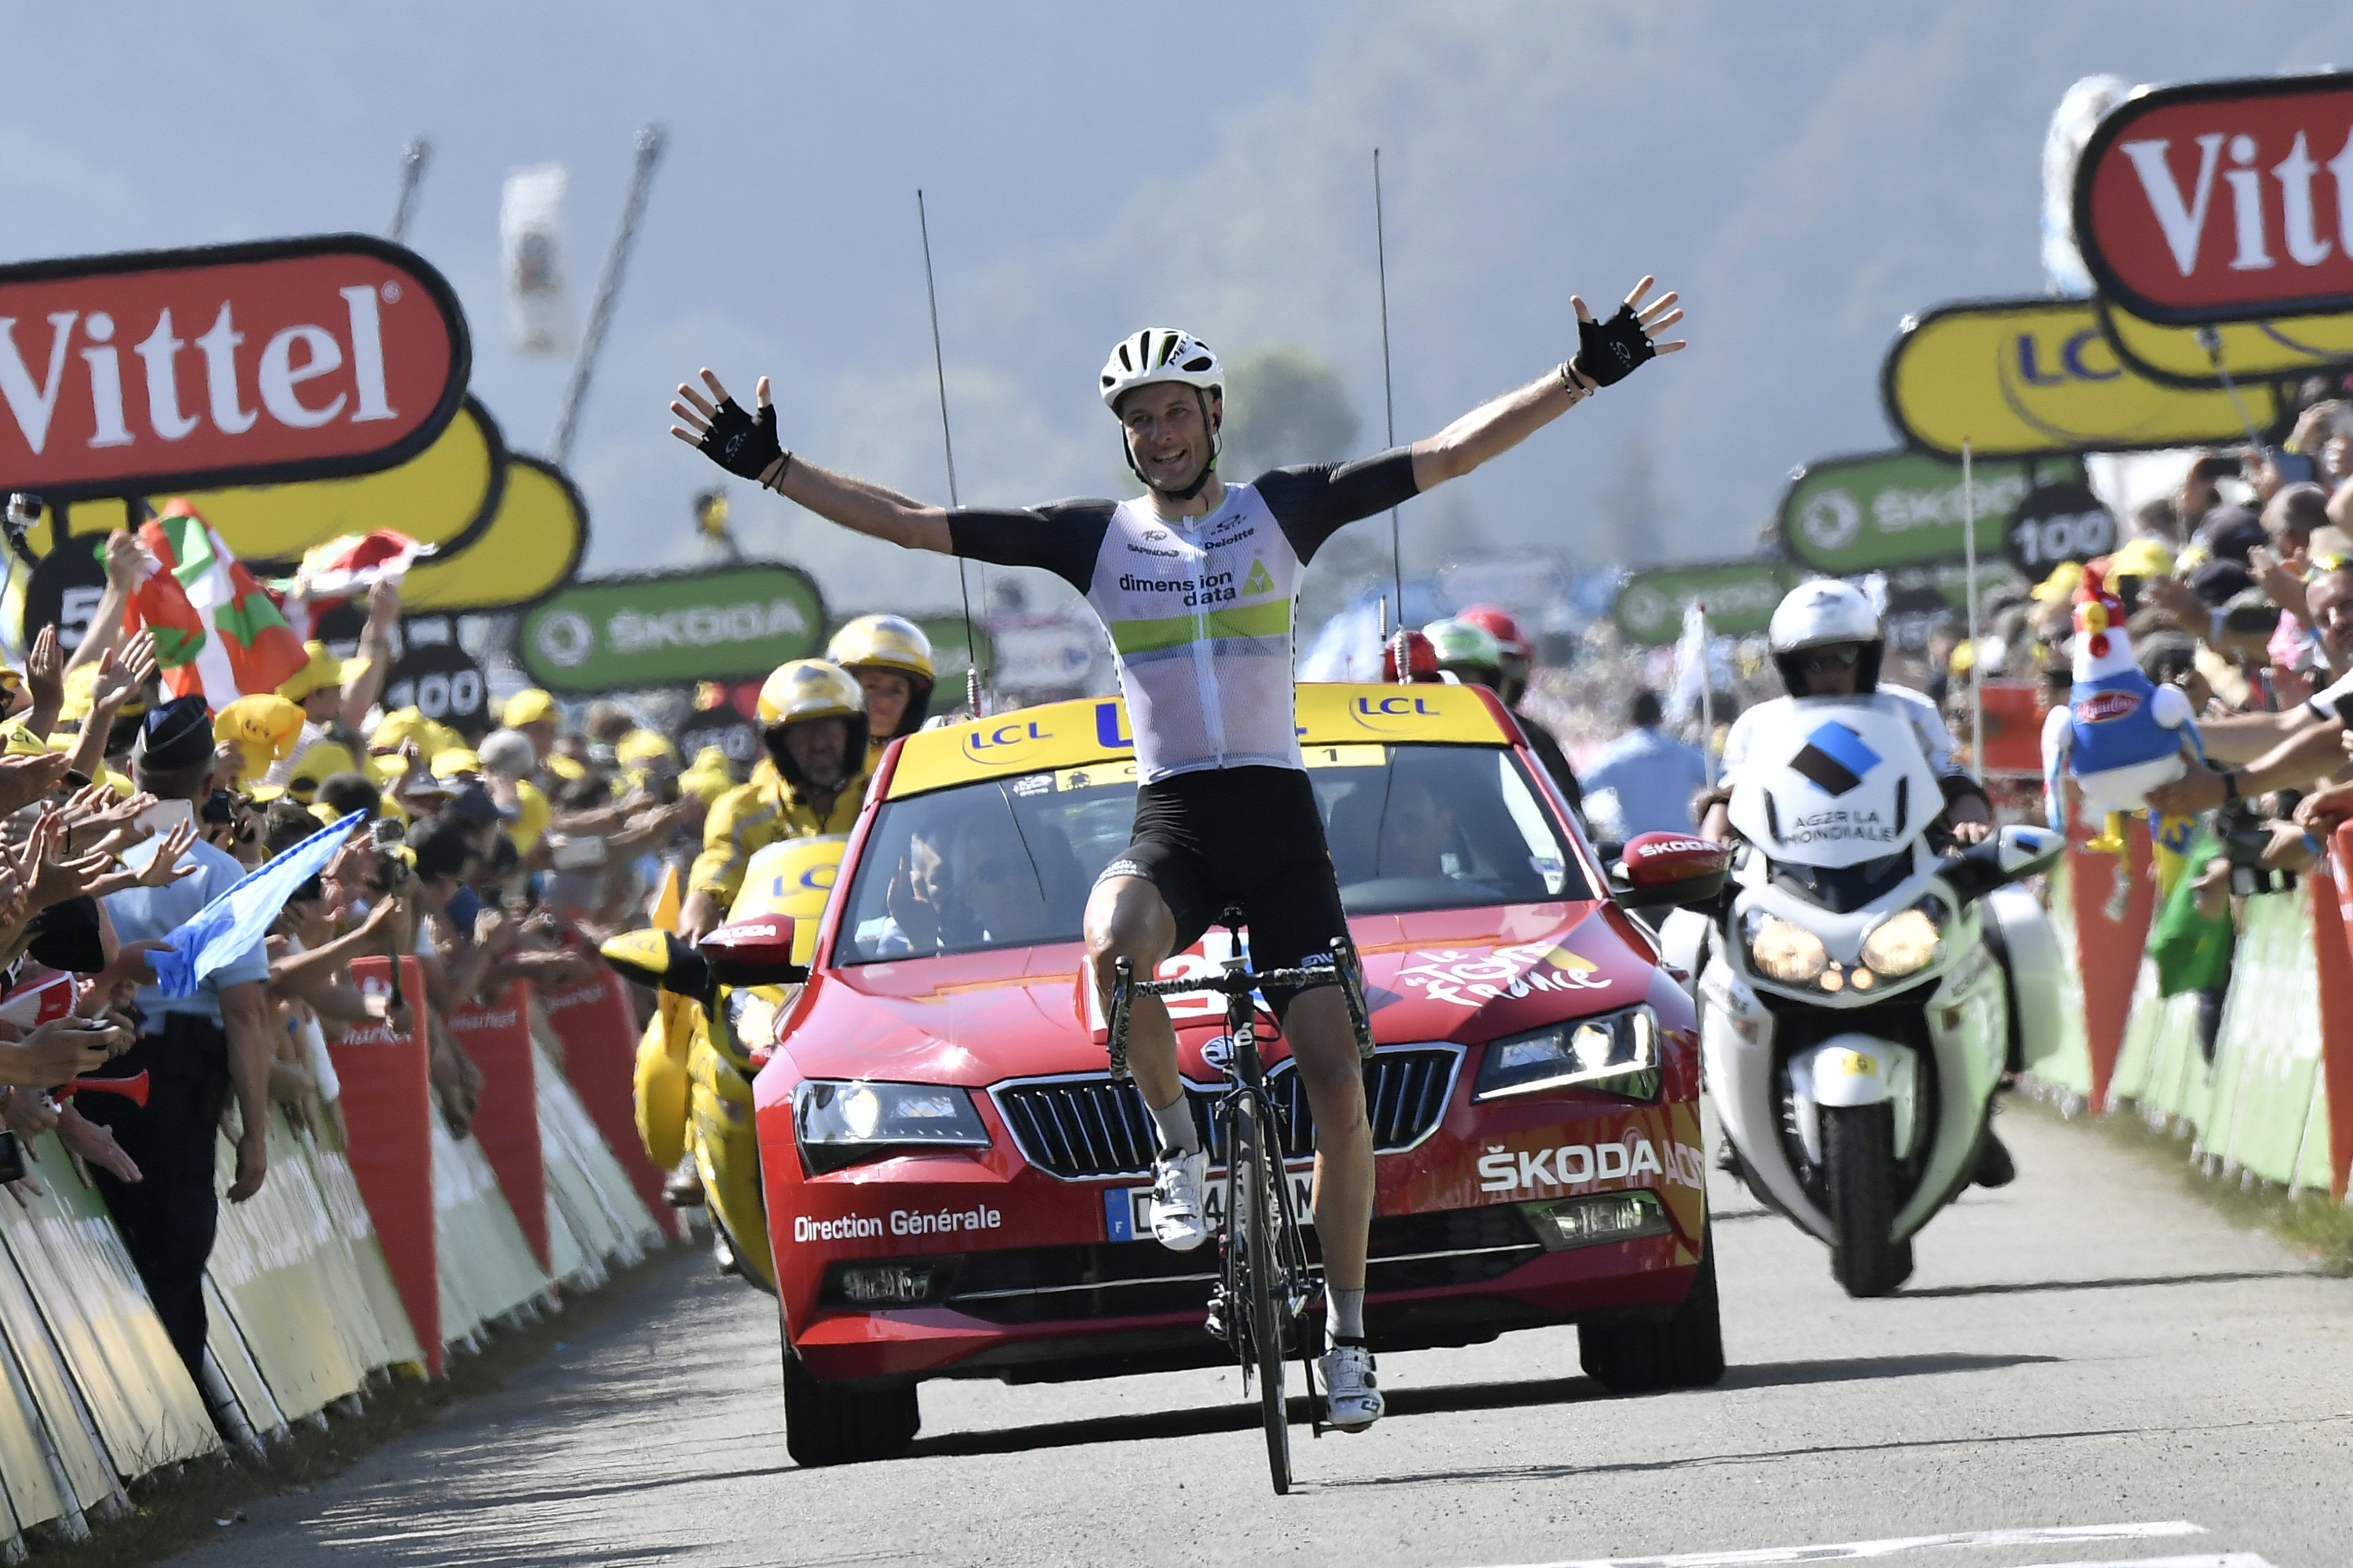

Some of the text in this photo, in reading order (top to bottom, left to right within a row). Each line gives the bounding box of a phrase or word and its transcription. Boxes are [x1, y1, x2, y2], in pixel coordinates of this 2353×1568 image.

[2016, 327, 2122, 387] LC
[1872, 472, 2056, 533] ŠKOD
[1204, 527, 1254, 550] Deloitte
[2010, 508, 2112, 565] 100
[1119, 572, 1232, 592] dimension
[1183, 586, 1236, 607] data
[61, 586, 103, 650] 5
[1358, 697, 1441, 715] LCL
[10, 731, 35, 745] CL
[971, 722, 1053, 750] LCL
[1321, 748, 1337, 762] 1
[772, 863, 838, 898] LC
[1479, 1139, 1663, 1192] ŠKODA
[795, 1204, 1001, 1243] Direction Générale
[1115, 1221, 1122, 1233] F
